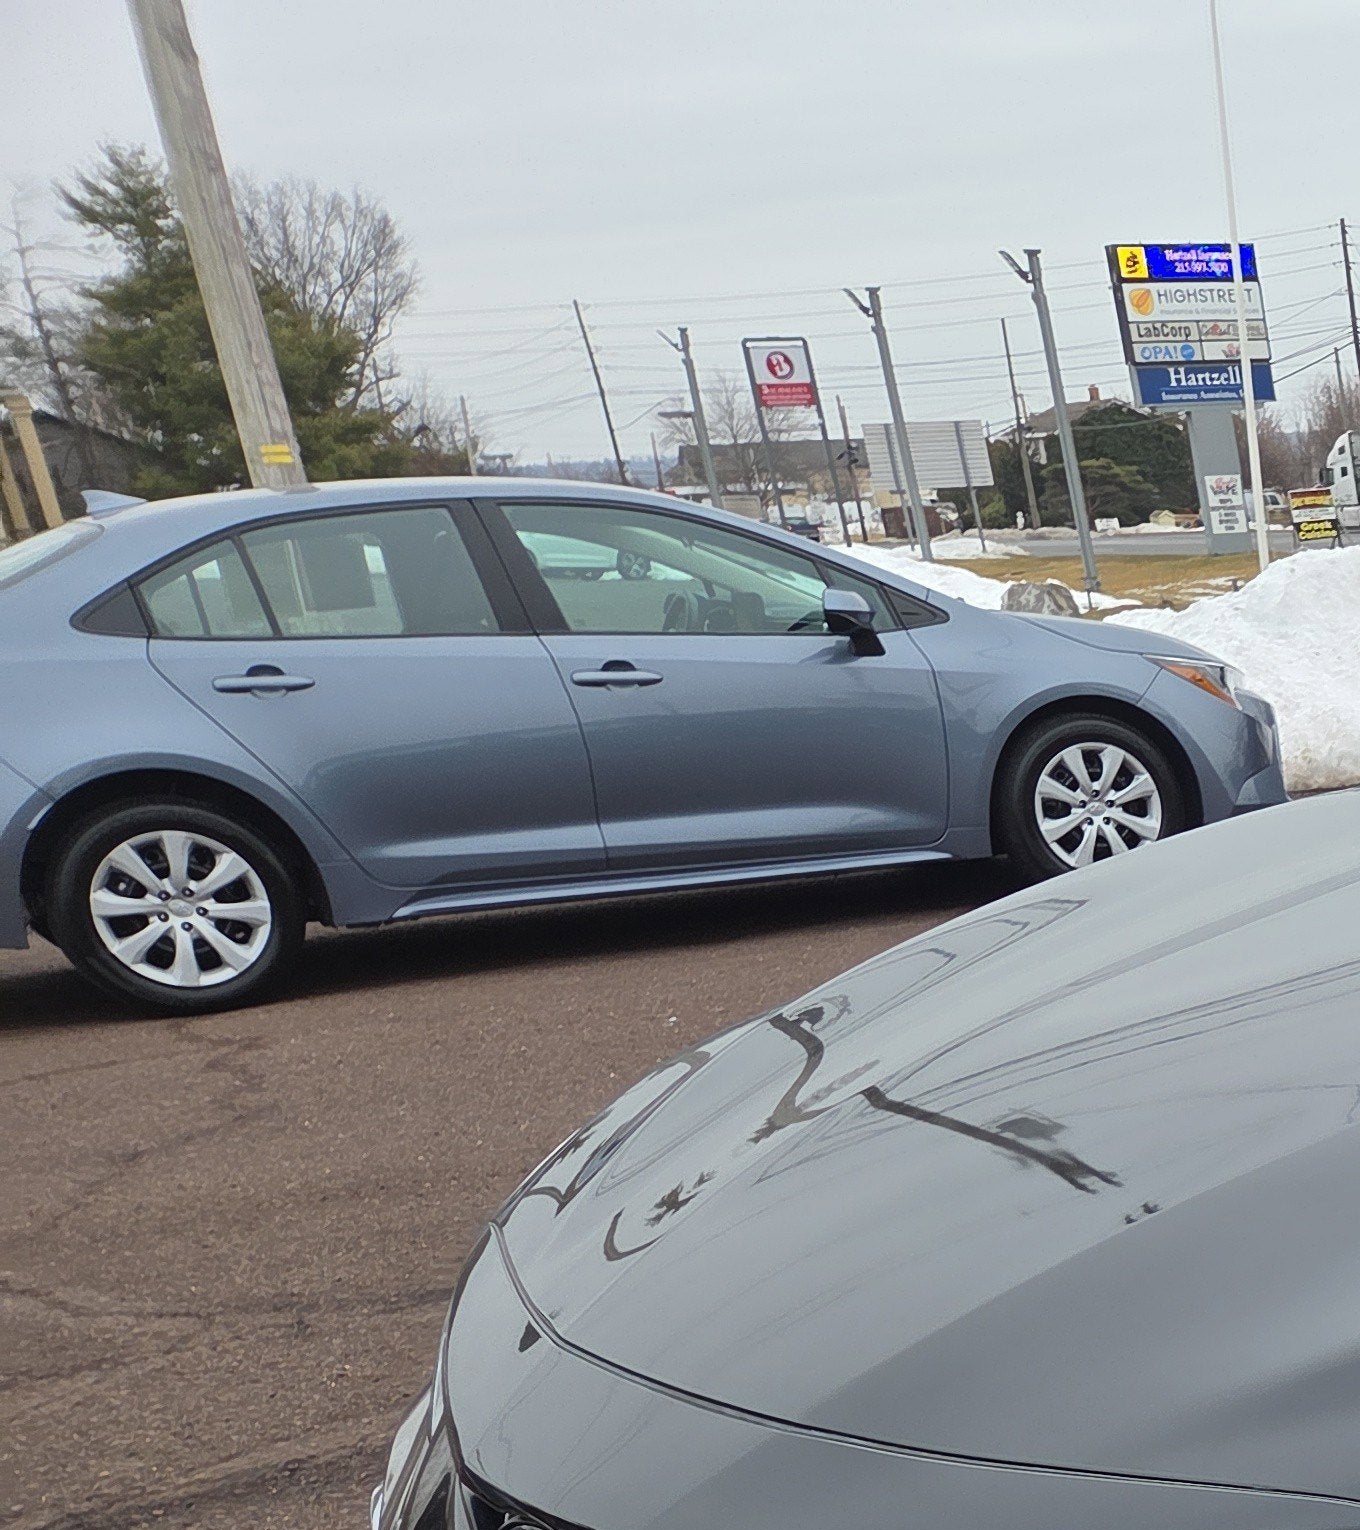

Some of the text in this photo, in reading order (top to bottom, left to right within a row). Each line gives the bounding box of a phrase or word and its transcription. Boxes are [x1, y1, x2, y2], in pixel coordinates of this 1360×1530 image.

[1156, 288, 1252, 304] HIGHSTRET
[1136, 323, 1191, 340] LabCorp
[1140, 345, 1179, 360] OPA!
[1167, 365, 1241, 387] Hartzell
